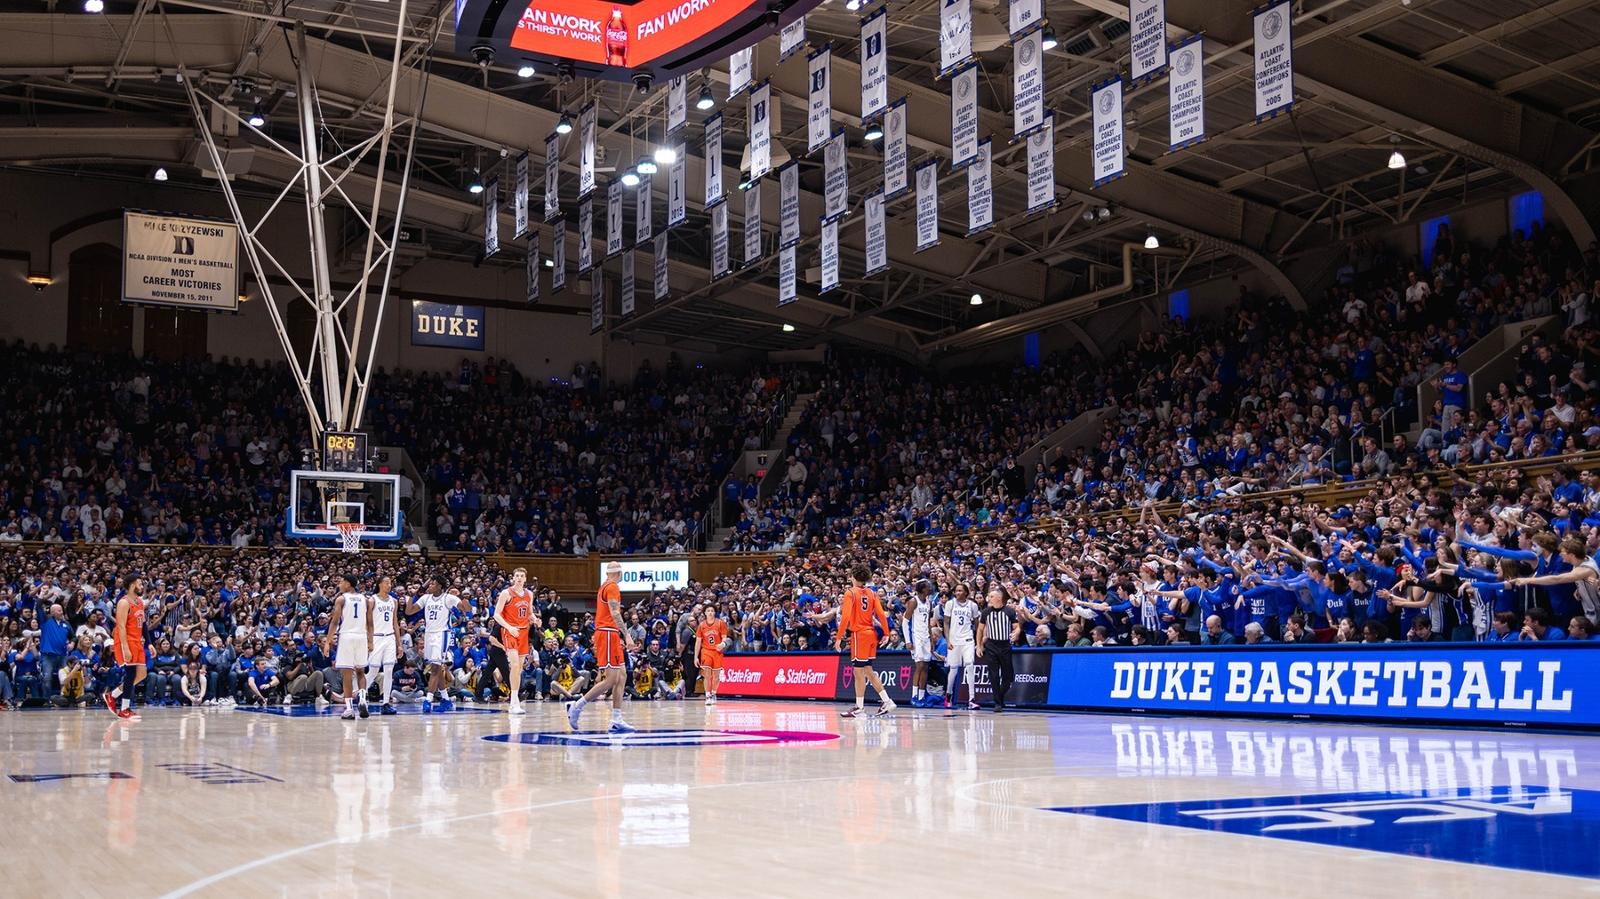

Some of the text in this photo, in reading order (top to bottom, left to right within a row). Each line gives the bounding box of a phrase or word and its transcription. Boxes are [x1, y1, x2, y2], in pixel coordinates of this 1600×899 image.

[522, 8, 601, 34] AN WORK
[1135, 5, 1158, 22] ATLANTIC
[637, 15, 665, 40] FAN
[1139, 16, 1154, 30] COAST
[527, 22, 601, 43] THIRSTY WORK
[1132, 21, 1163, 43] CONFERENCE
[1133, 32, 1161, 52] CHAMPIONS
[1260, 43, 1285, 60] ATLANTIC
[1264, 55, 1281, 68] COAST
[1018, 68, 1037, 83] ATLANTIC
[1256, 59, 1290, 80] CONFERENCE
[1021, 78, 1034, 90] COAST
[1175, 79, 1197, 93] ATLANTIC
[1257, 70, 1289, 89] CHAMPIONS
[1015, 83, 1041, 102] CONFERENCE
[1178, 89, 1193, 101] COAST
[1016, 93, 1040, 110] CHAMPIONS
[1171, 95, 1201, 112] CONFERENCE
[1266, 94, 1281, 107] 2005
[1172, 105, 1200, 121] CHAMPIONS
[953, 117, 976, 134] CONFERENCE
[1098, 119, 1117, 132] ATLANTIC
[1180, 126, 1193, 137] 2004
[954, 127, 975, 142] CHAMPIONS
[1101, 129, 1115, 140] COAST
[1095, 134, 1121, 151] CONFERENCE
[1096, 143, 1120, 158] CHAMPIONS
[146, 255, 172, 263] DIVISION
[199, 260, 233, 269] BASKETBALL
[171, 269, 195, 278] MOST
[143, 275, 222, 291] CAREER VICTORIES
[152, 291, 185, 299] NOVEMBER
[418, 315, 478, 337] DUKE
[655, 571, 678, 581] LION
[353, 603, 358, 619] 1
[861, 598, 868, 611] 5
[384, 612, 390, 622] 6
[429, 611, 438, 620] 21
[959, 616, 964, 625] 3
[709, 636, 714, 644] 2
[1015, 674, 1047, 682] REEDS.com
[1110, 661, 1572, 712] DUKE BASKETBALL
